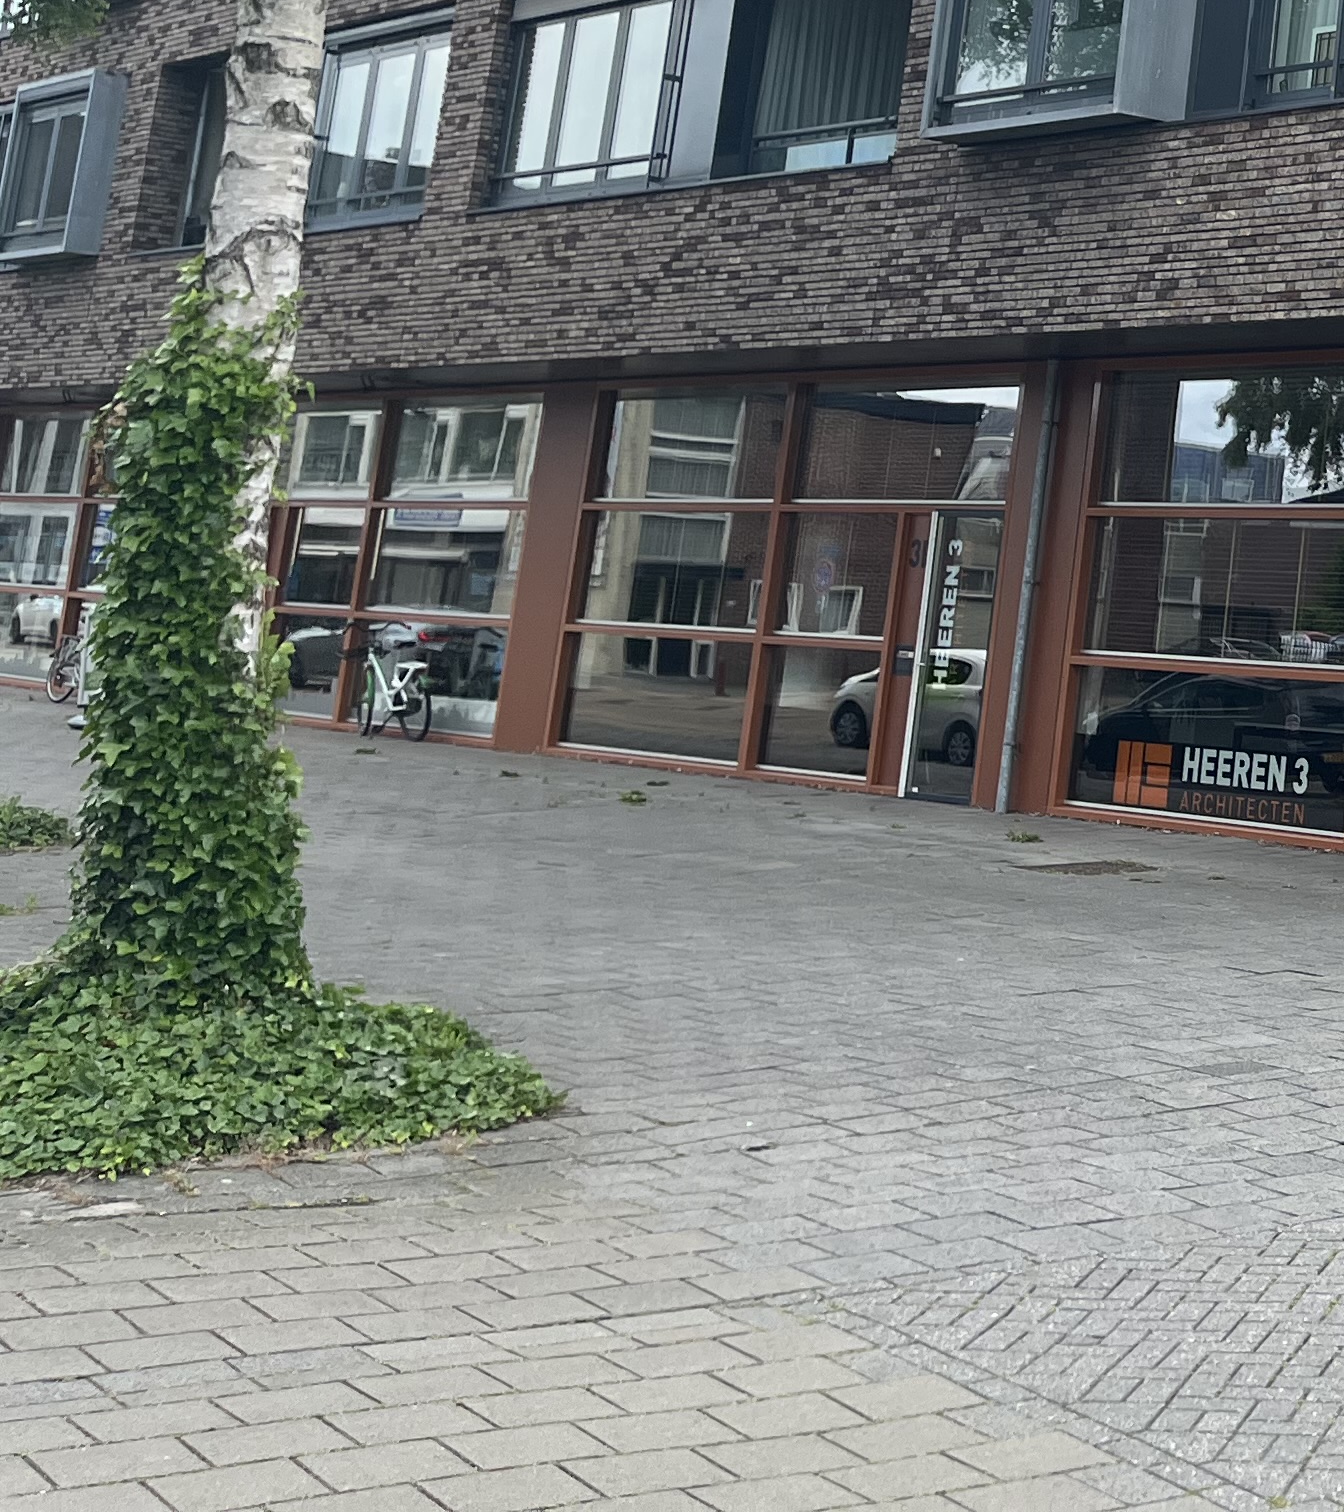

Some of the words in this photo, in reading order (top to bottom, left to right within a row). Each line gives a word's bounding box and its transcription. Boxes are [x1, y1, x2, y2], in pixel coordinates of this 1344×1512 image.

[931, 565, 961, 689] HEEREN
[948, 539, 963, 556] 3
[1181, 746, 1287, 793] HEEREN
[1292, 757, 1310, 795] 3
[1179, 790, 1306, 825] ARCHITECTEN
